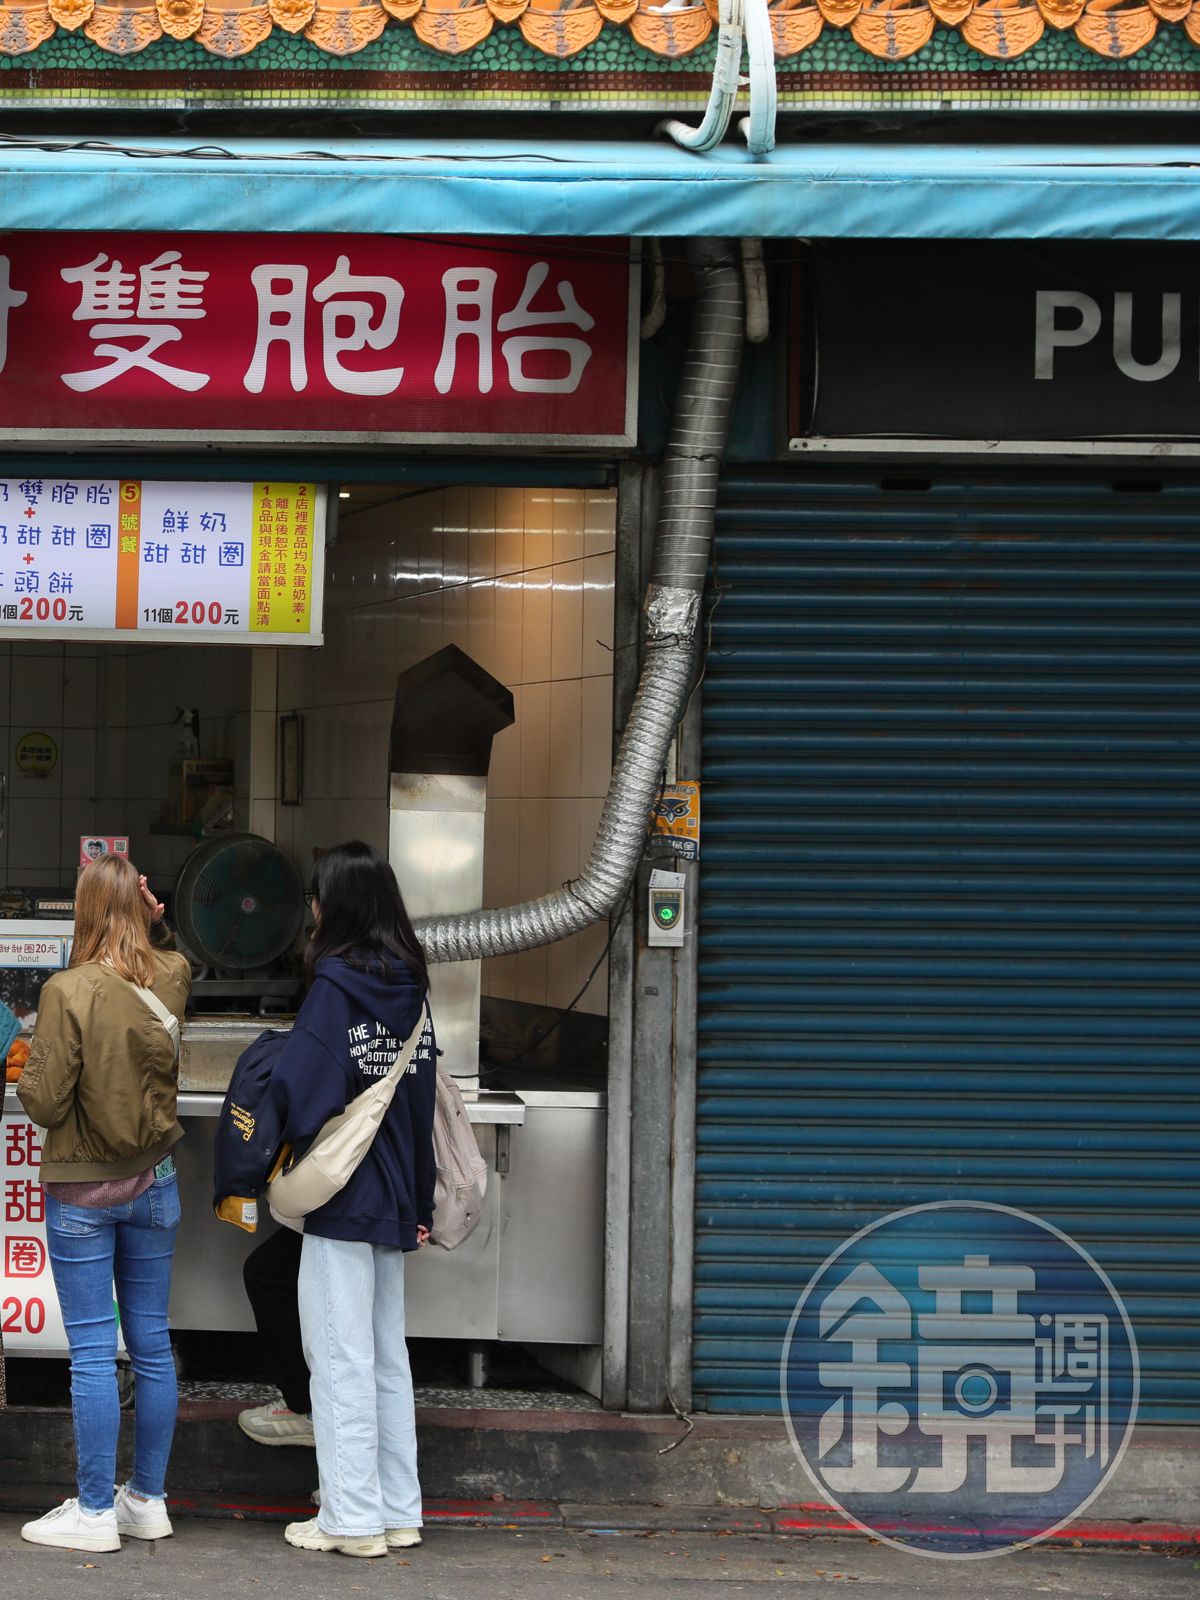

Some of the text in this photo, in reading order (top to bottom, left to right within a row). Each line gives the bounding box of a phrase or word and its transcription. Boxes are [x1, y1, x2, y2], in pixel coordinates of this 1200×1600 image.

[1034, 290, 1200, 382] PU
[161, 509, 227, 534] 鮮奶
[143, 541, 244, 567] 甜甜圈
[143, 601, 240, 626] 11個200元
[0, 943, 59, 954] 甜甜圈20元
[17, 954, 40, 963] Donut
[347, 1023, 370, 1044] THE
[370, 1038, 383, 1049] OF
[385, 1038, 397, 1049] THE
[1, 1123, 46, 1334] 甜甜圈 20
